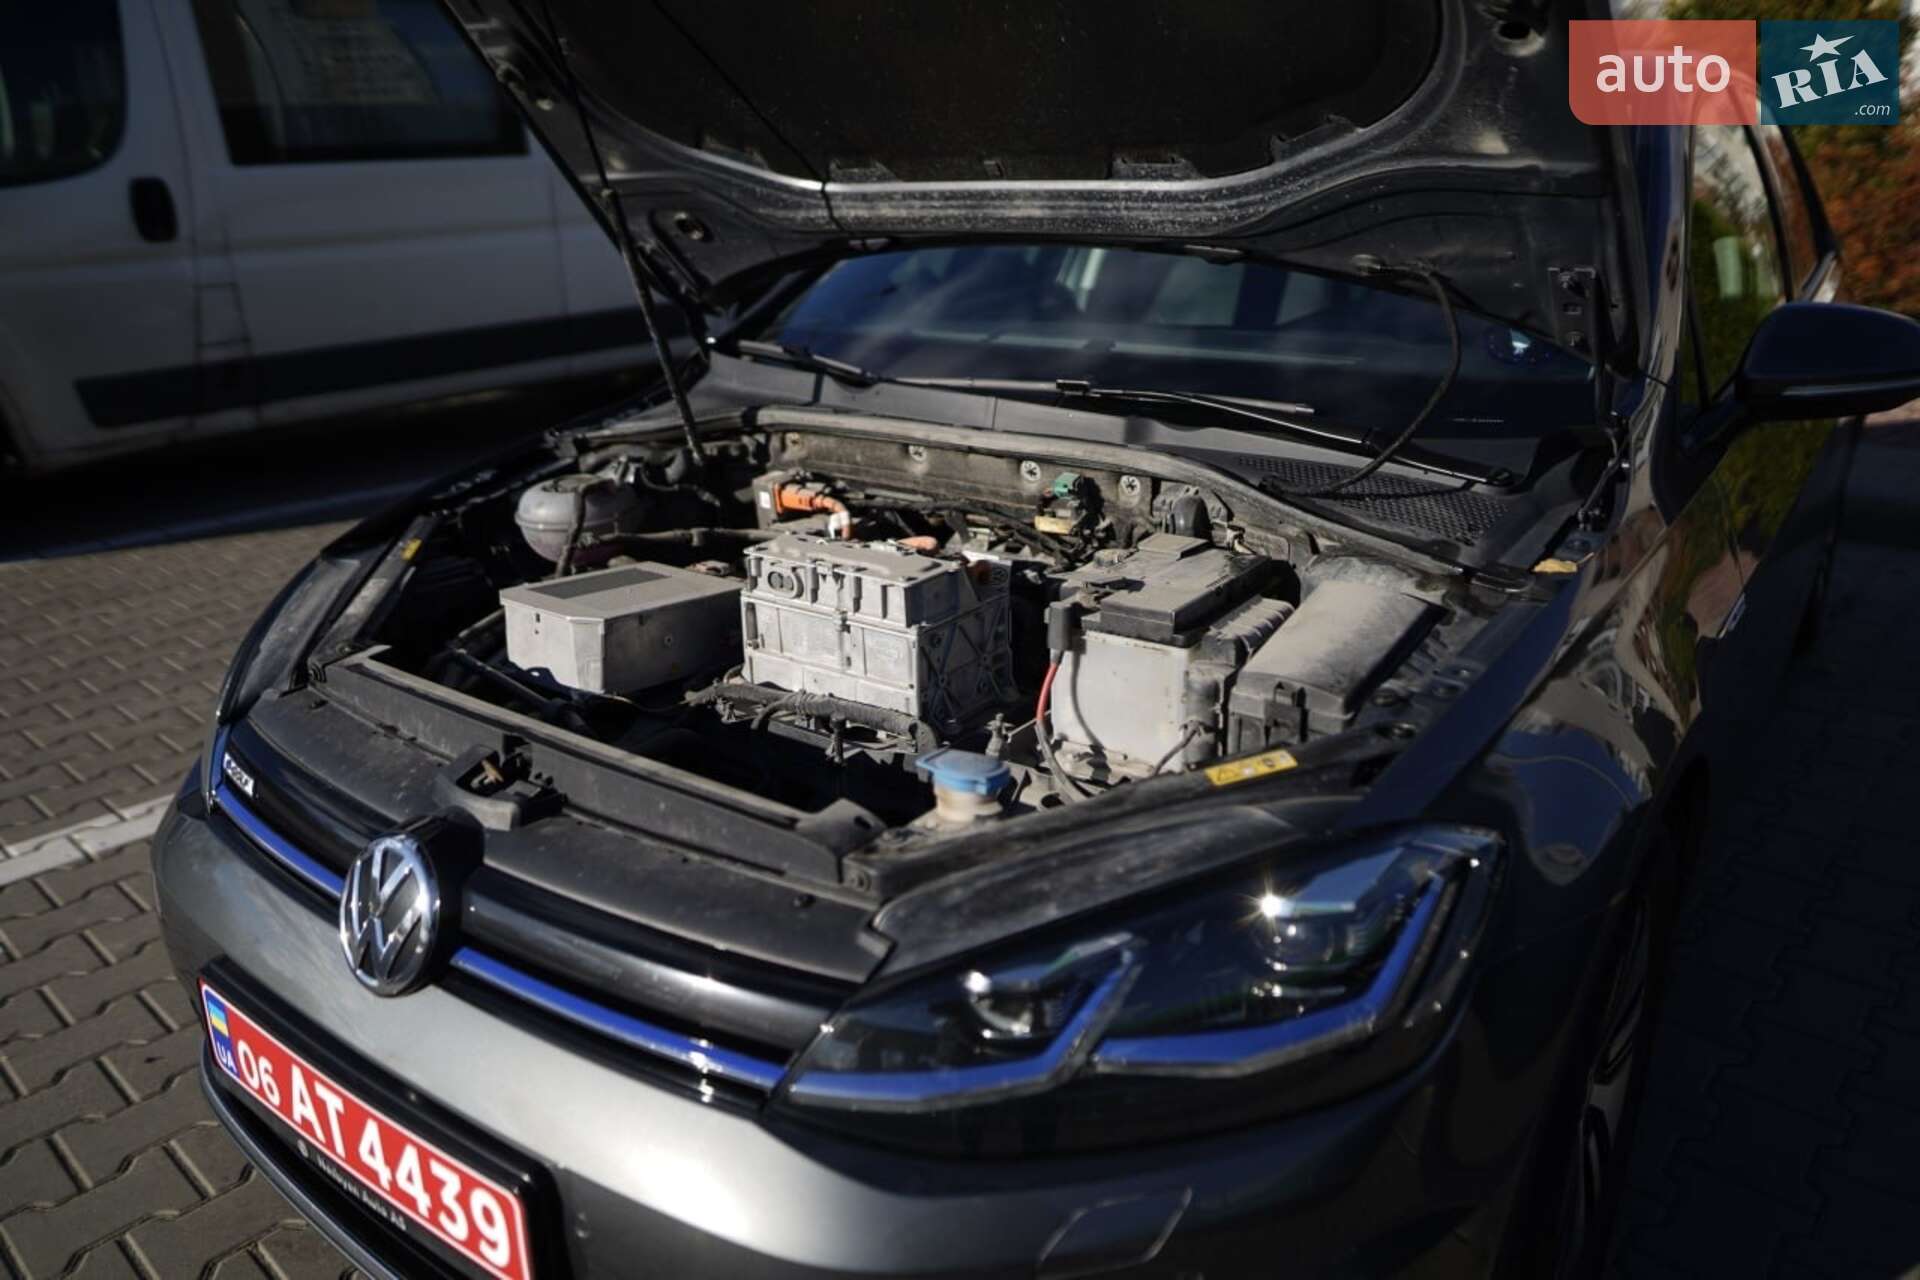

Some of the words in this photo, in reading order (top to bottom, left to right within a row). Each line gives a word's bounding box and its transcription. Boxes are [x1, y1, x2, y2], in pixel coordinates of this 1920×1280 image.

[216, 1041, 238, 1073] UA
[237, 1039, 281, 1108] 06
[291, 1063, 346, 1160] AT
[358, 1118, 511, 1268] 4439
